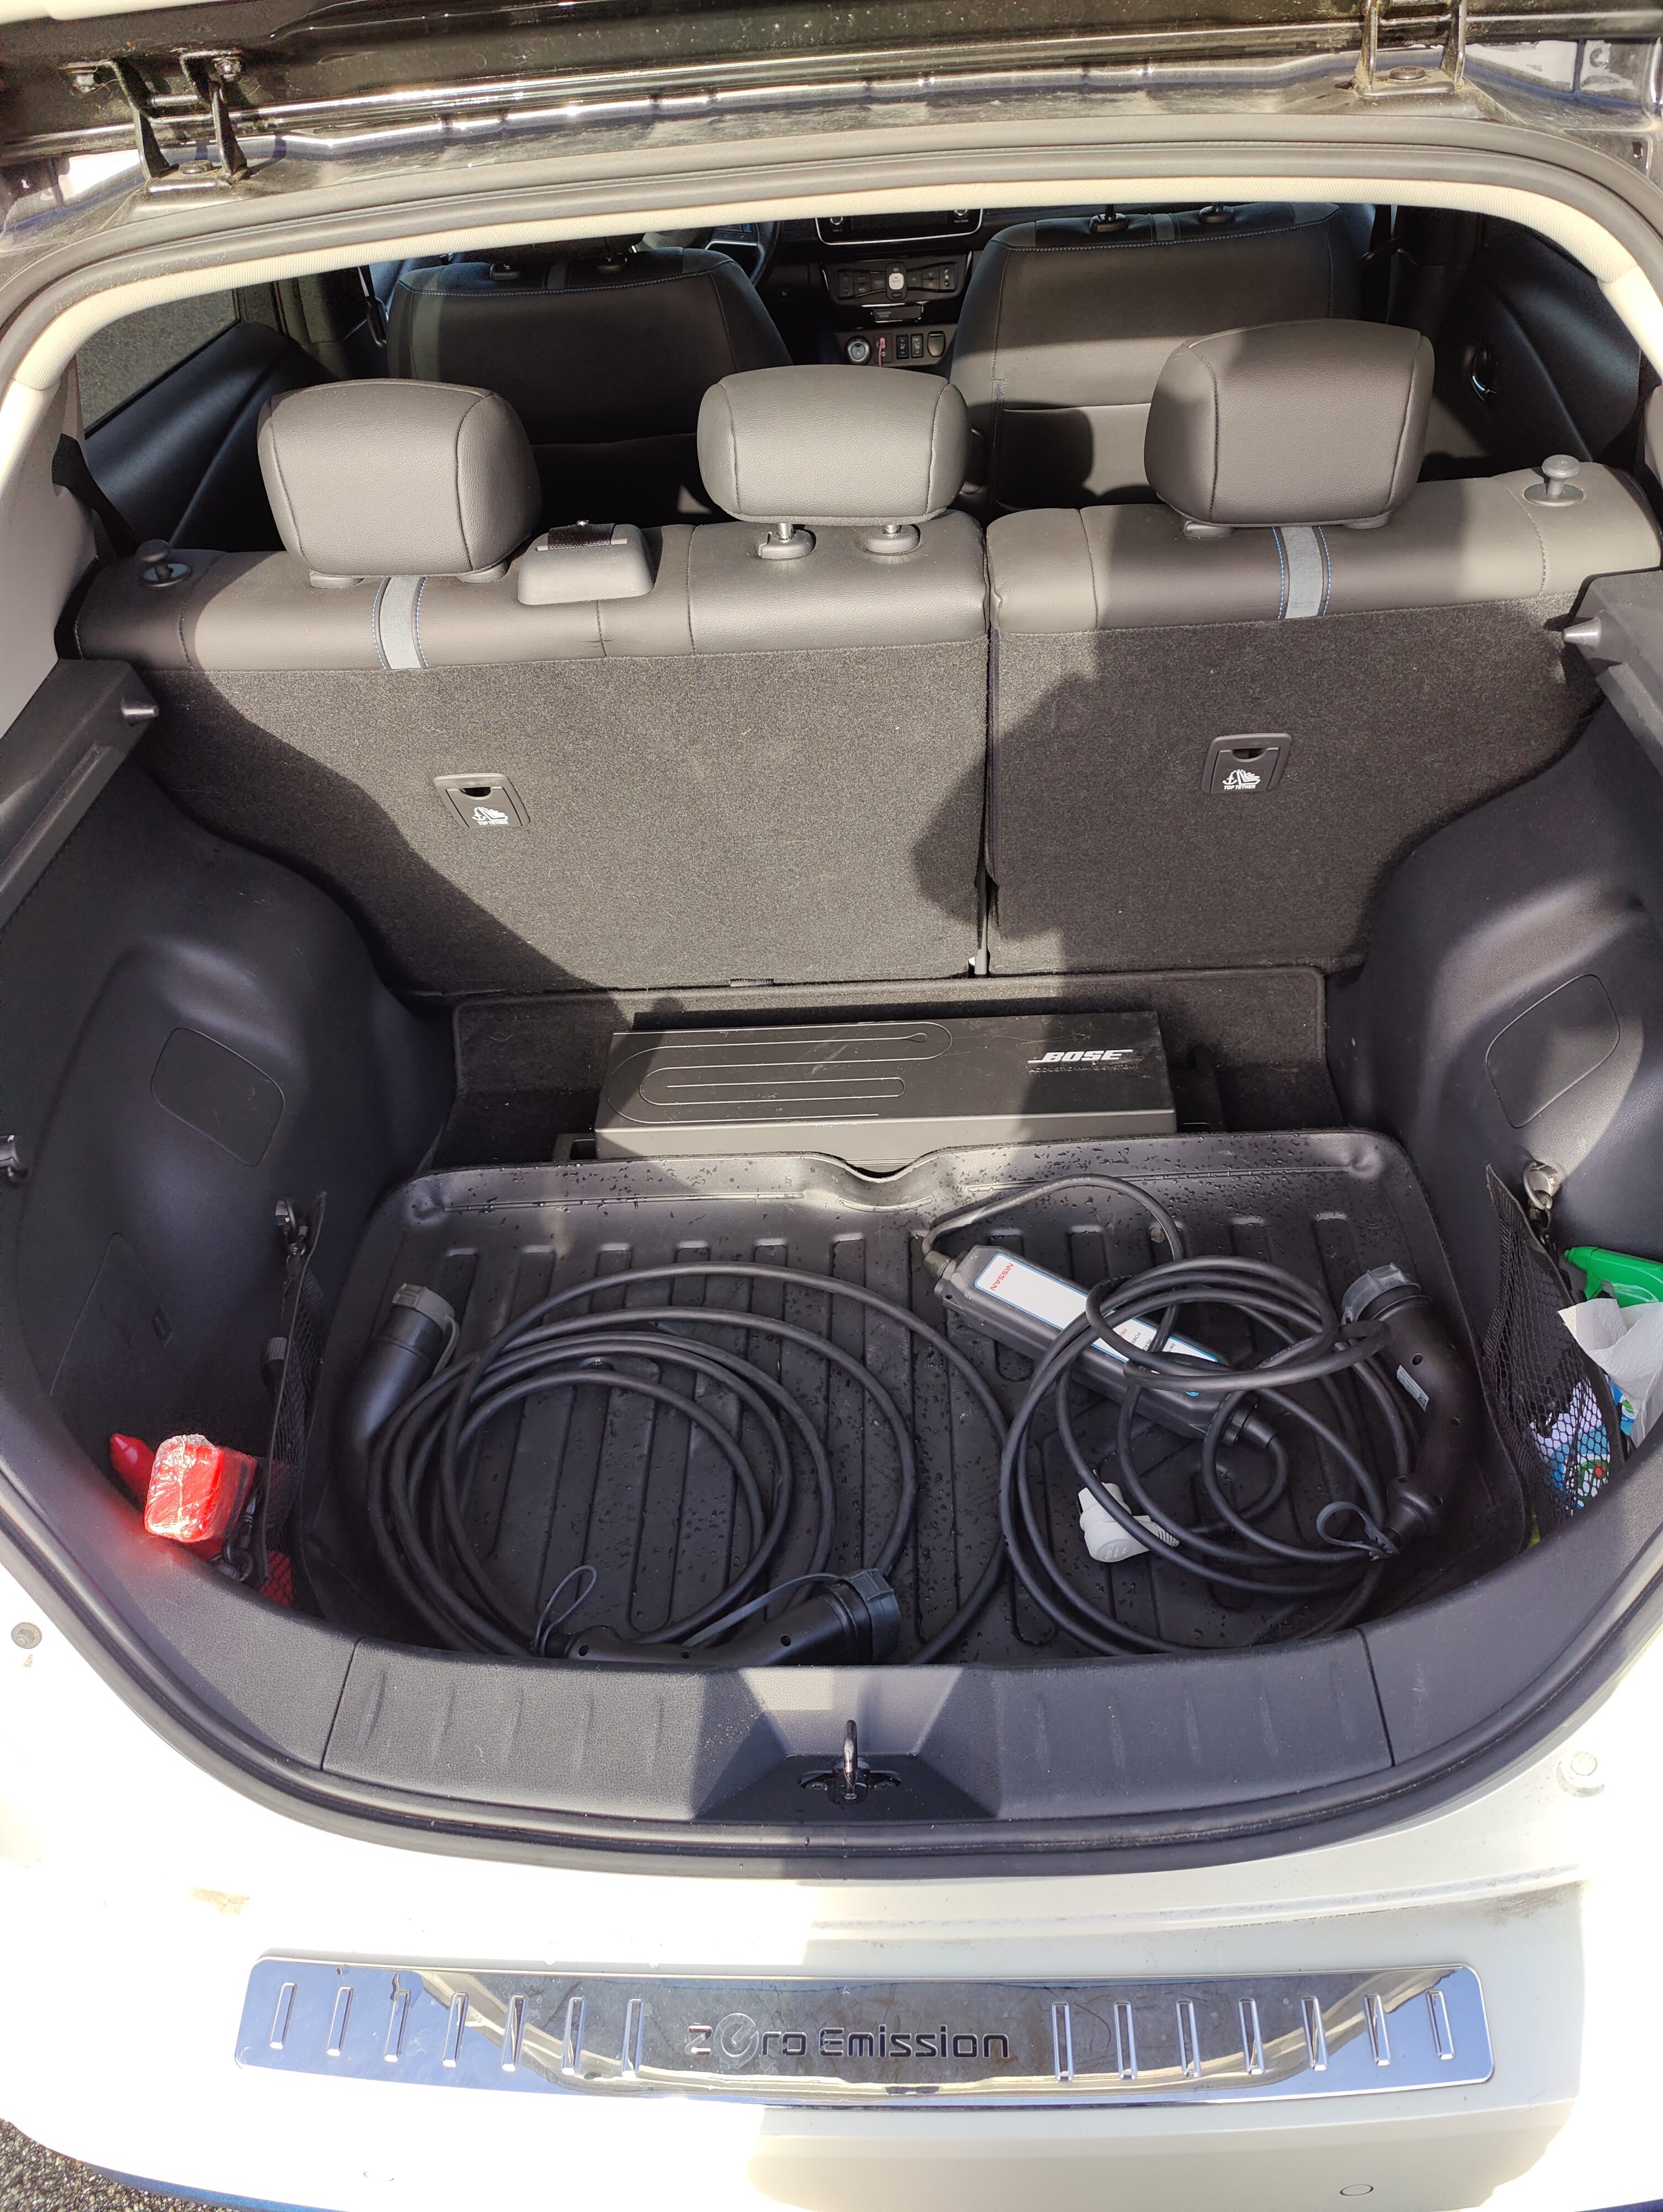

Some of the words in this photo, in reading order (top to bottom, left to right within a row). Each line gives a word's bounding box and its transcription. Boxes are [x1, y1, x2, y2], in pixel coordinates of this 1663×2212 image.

[1028, 1049, 1133, 1064] BOSE
[990, 1262, 1014, 1291] NISSAN
[1131, 1332, 1141, 1344] POWE
[819, 2023, 1010, 2058] Emission
